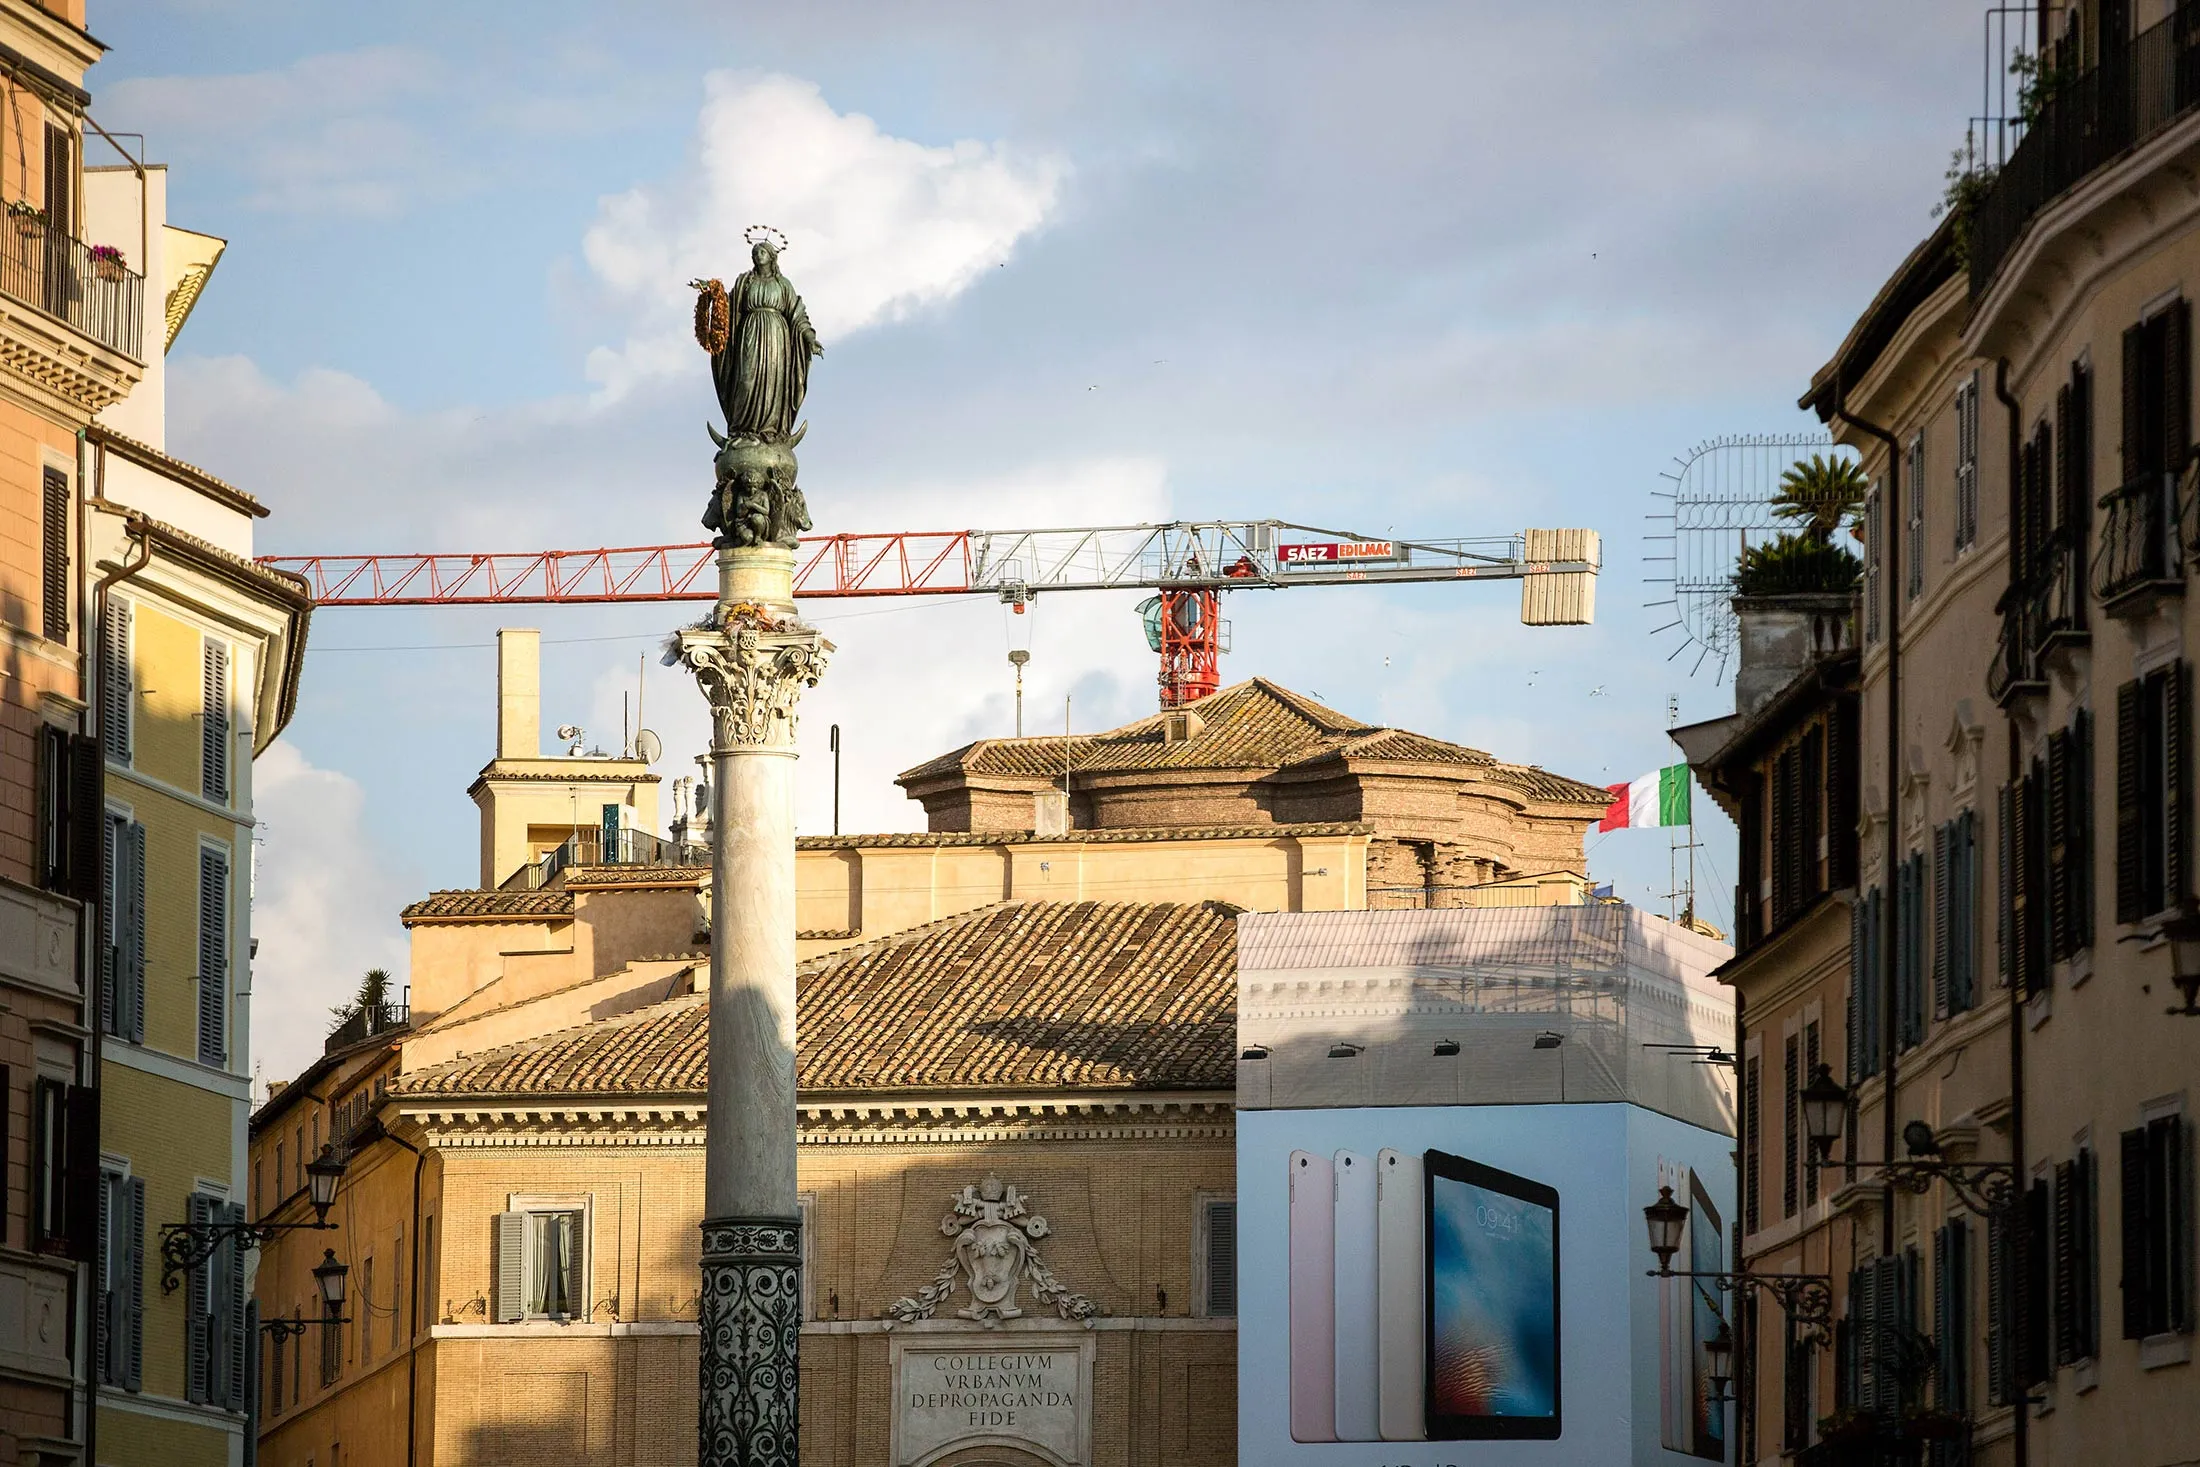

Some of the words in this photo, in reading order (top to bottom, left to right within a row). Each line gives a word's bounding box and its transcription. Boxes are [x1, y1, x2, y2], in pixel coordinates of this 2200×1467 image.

[1339, 542, 1392, 557] EDILMAC
[934, 1355, 1053, 1371] COLLEGIVM
[945, 1374, 1043, 1389] VRBANVM
[969, 1411, 1017, 1426] FIDE
